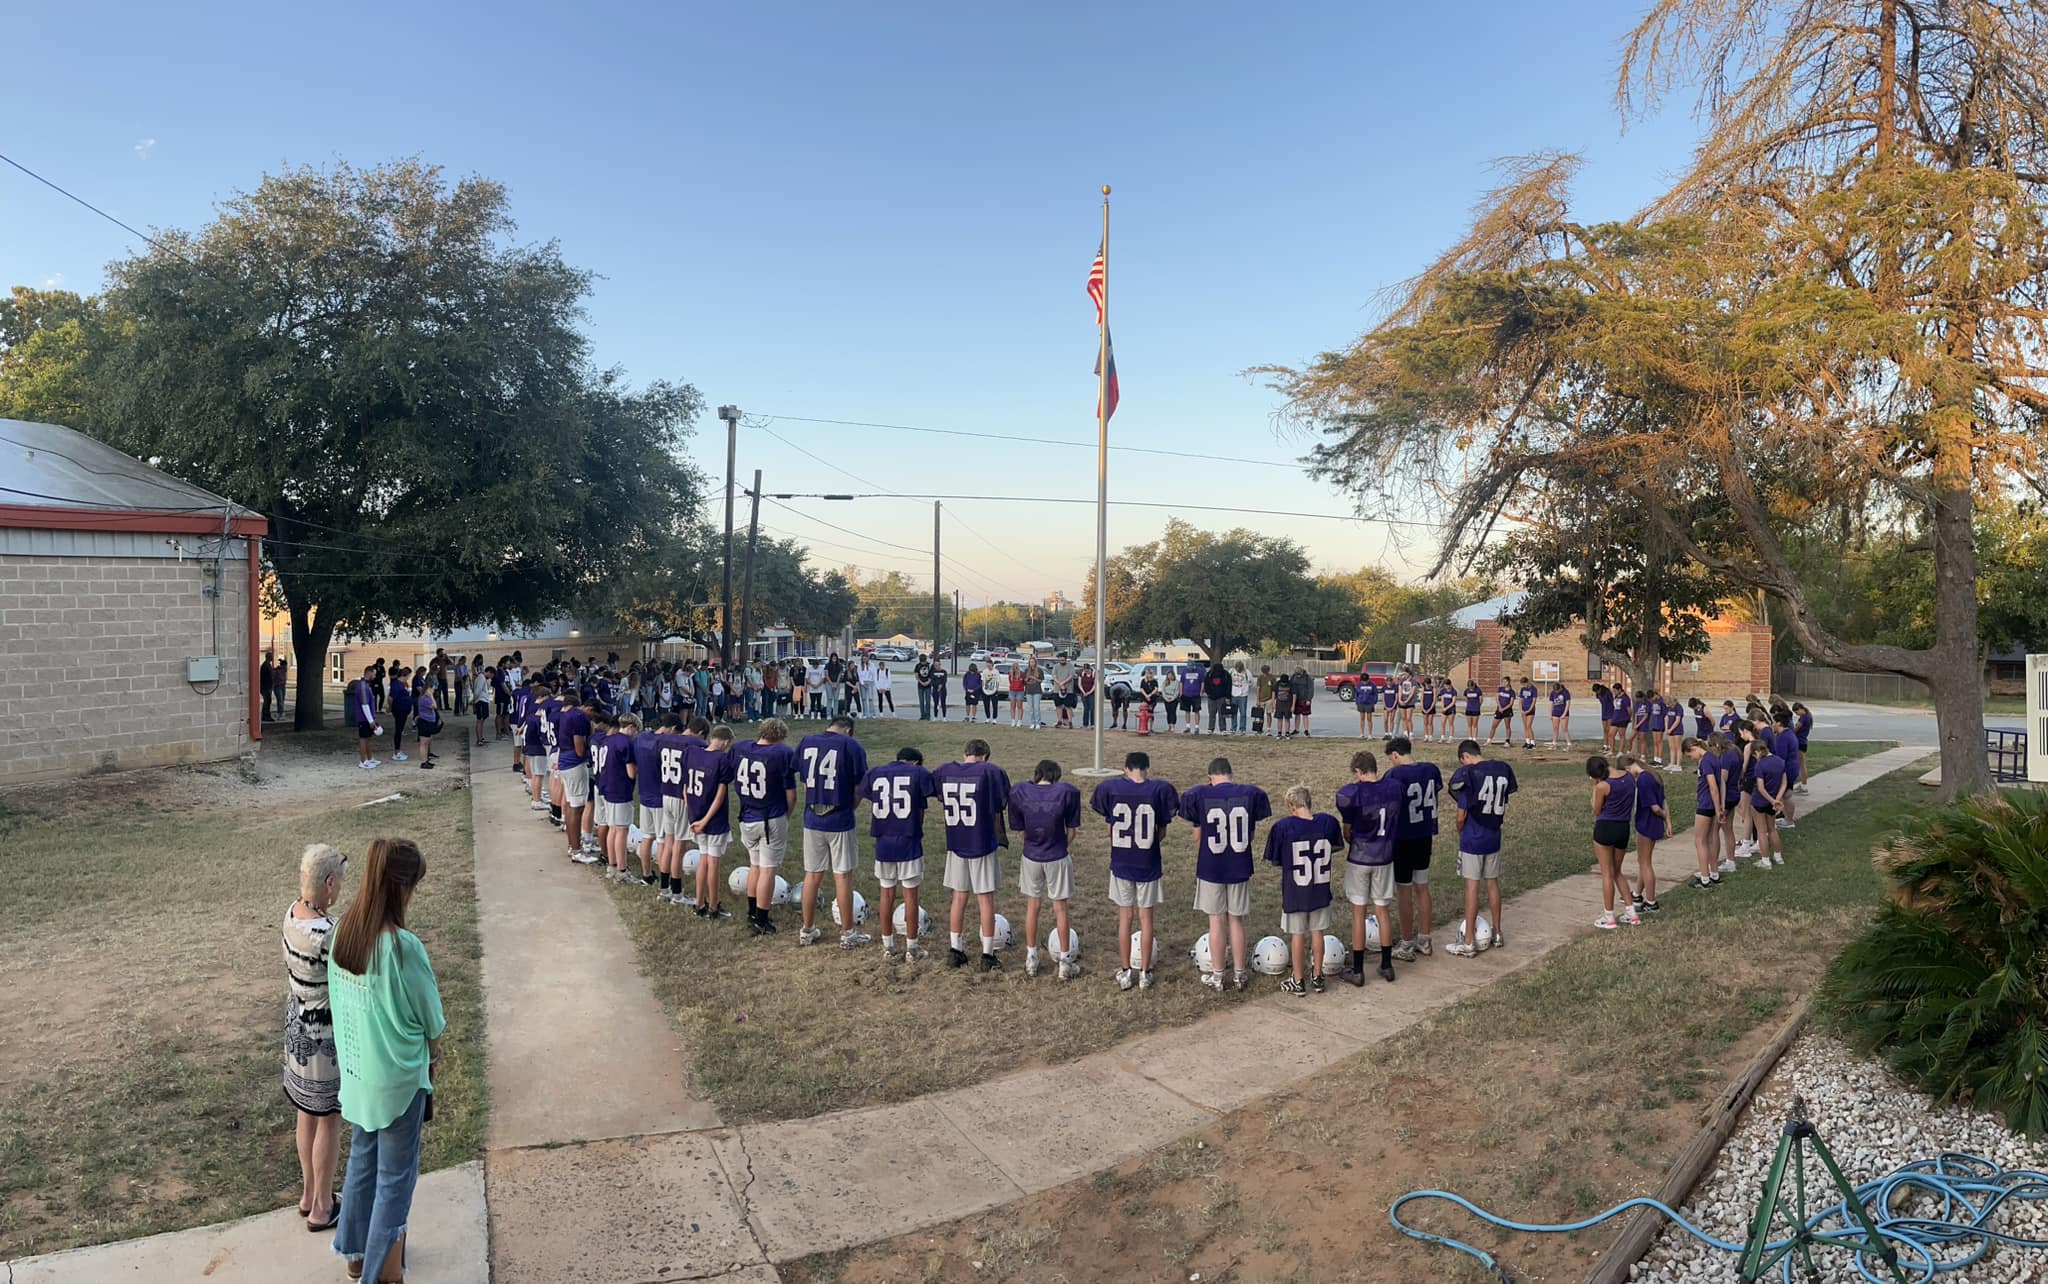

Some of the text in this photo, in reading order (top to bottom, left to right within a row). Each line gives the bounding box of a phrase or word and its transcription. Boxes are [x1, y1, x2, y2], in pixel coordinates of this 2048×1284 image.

[660, 747, 683, 785] 85
[687, 768, 705, 797] 15
[736, 757, 767, 800] 43
[803, 747, 838, 790] 74
[872, 776, 911, 819] 35
[942, 782, 977, 827] 55
[1407, 779, 1438, 824] 24
[1478, 775, 1509, 816] 40
[1112, 802, 1156, 849] 20
[1206, 806, 1249, 854] 30
[1376, 807, 1387, 837] 1
[1292, 838, 1332, 887] 52
